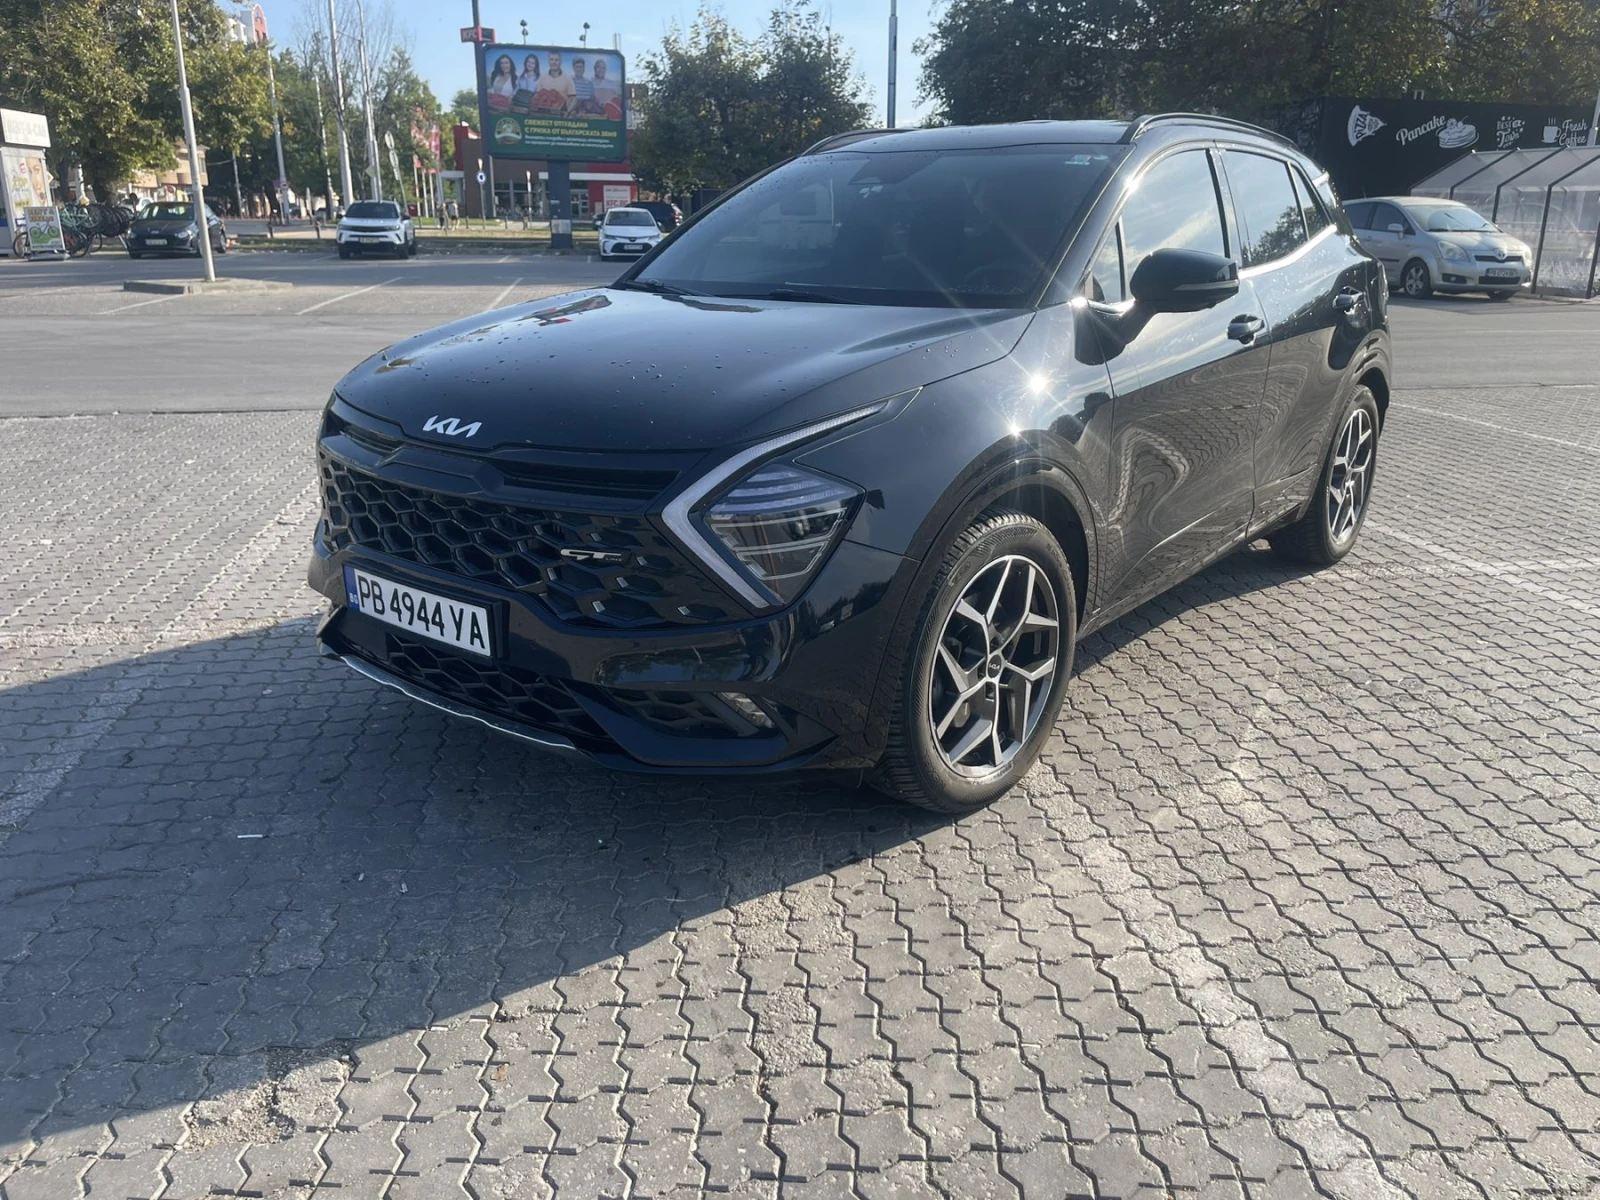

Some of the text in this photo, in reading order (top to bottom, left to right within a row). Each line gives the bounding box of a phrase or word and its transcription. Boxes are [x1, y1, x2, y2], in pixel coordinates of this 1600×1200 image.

[1396, 115, 1447, 145] Pancake
[1562, 119, 1587, 132] Fresh
[1559, 132, 1587, 147] Coffee
[357, 575, 485, 649] PB 4944 YA
